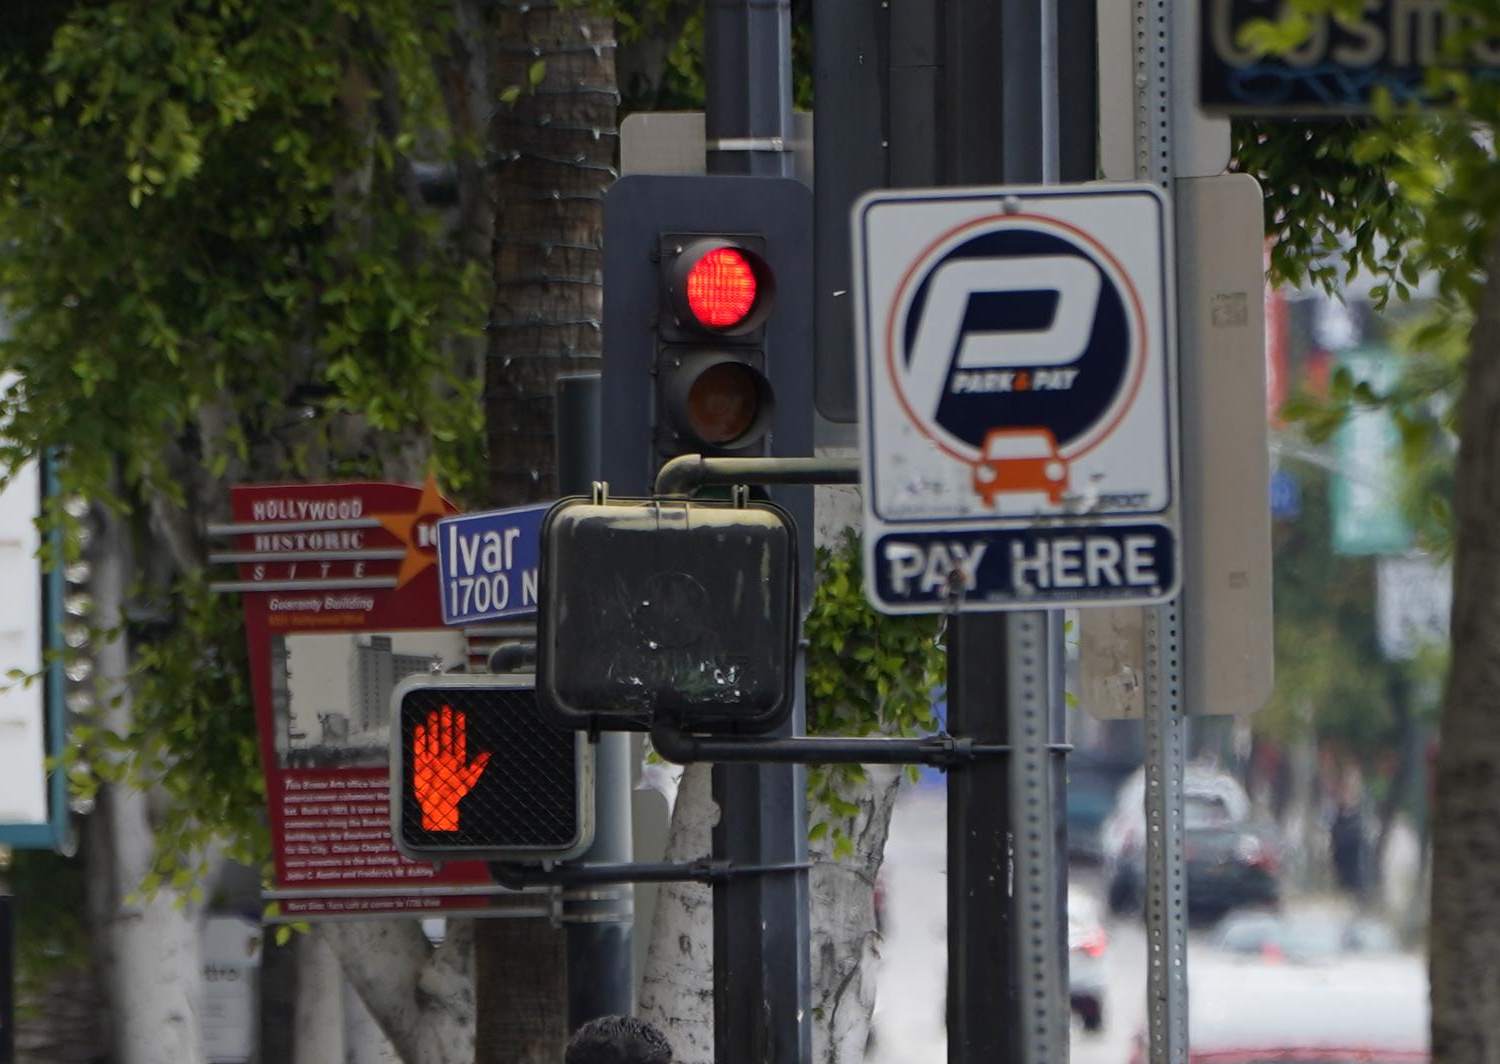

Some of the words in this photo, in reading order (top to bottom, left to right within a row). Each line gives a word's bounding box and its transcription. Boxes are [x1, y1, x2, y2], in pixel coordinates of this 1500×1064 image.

[951, 370, 1015, 394] PARK
[1031, 367, 1080, 391] PAY
[253, 498, 363, 521] HOLLYWOOD
[255, 530, 365, 552] HISTORIC
[449, 525, 520, 578] Ivar
[253, 562, 366, 581] SITE
[884, 541, 989, 598] PAY
[1010, 535, 1160, 590] HERE
[450, 573, 509, 617] 1700
[521, 567, 539, 606] N
